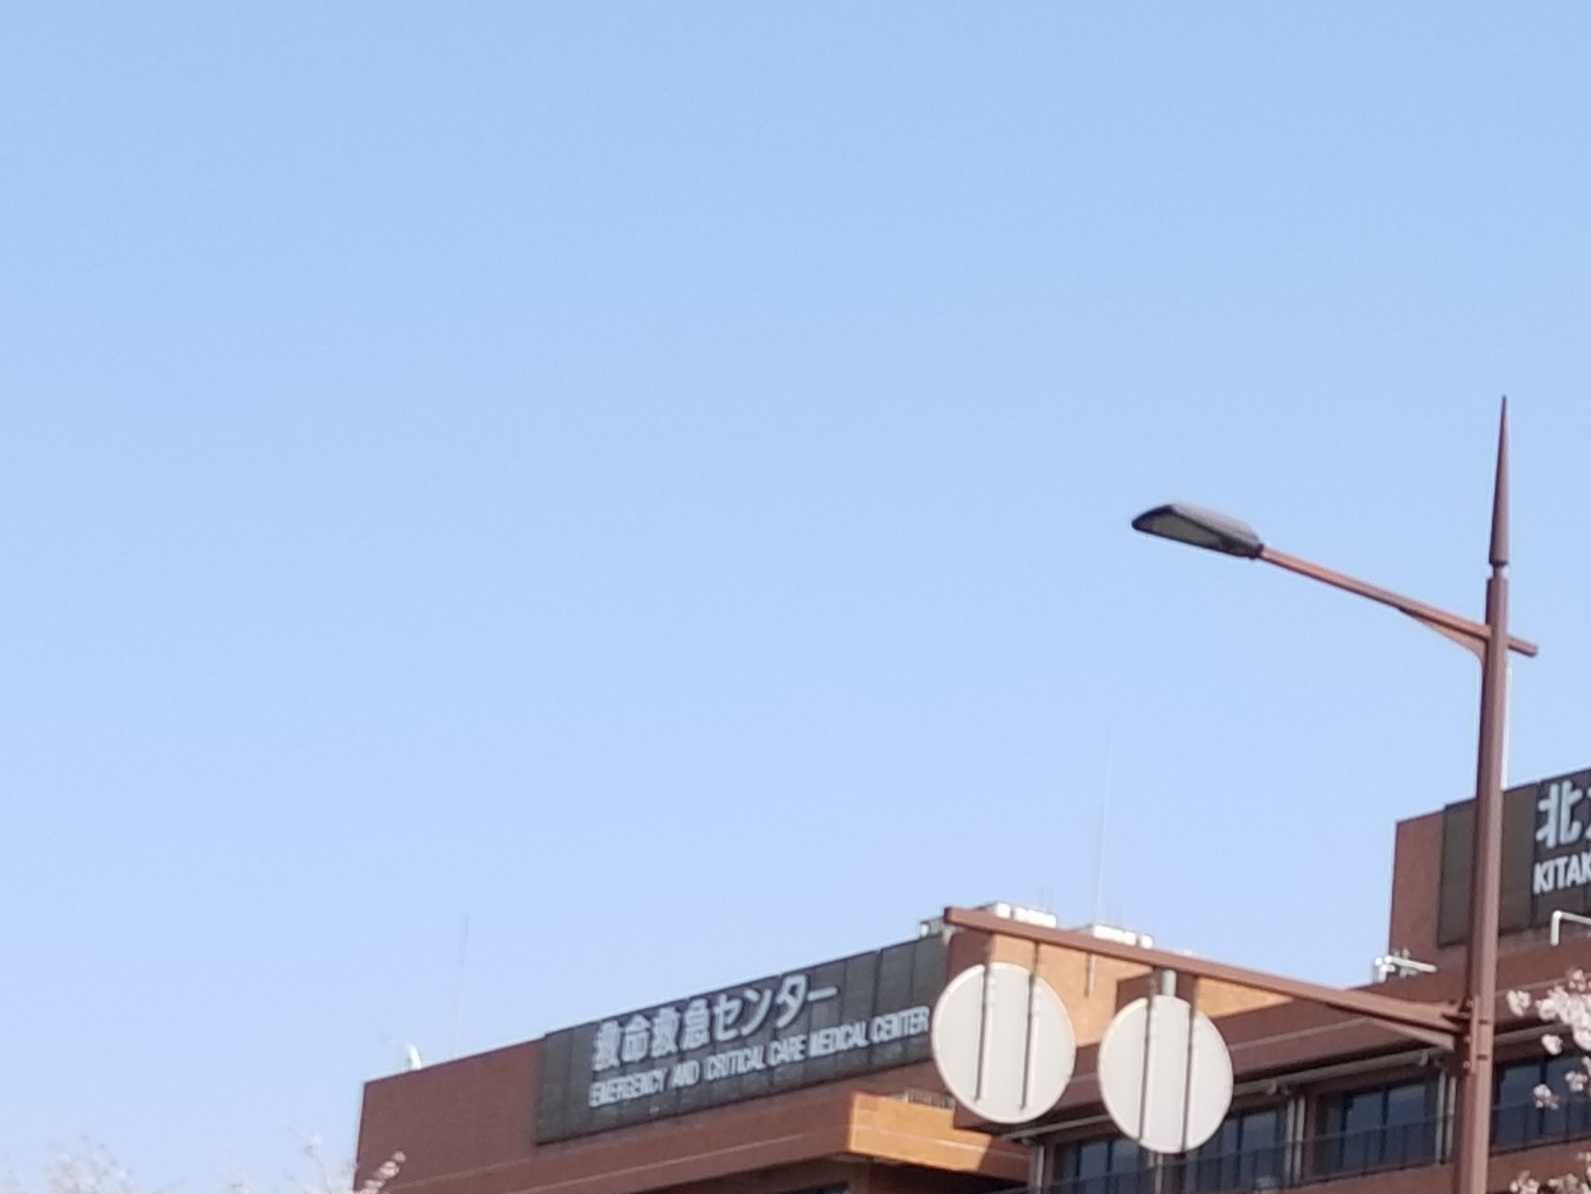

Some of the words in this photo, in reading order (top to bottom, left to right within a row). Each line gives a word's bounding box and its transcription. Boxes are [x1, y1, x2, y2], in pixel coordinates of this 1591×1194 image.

[593, 974, 839, 1072] 救命救急センター
[767, 1034, 808, 1067] CARE
[808, 1021, 869, 1057] MEDICAL
[869, 1005, 930, 1044] CENTER
